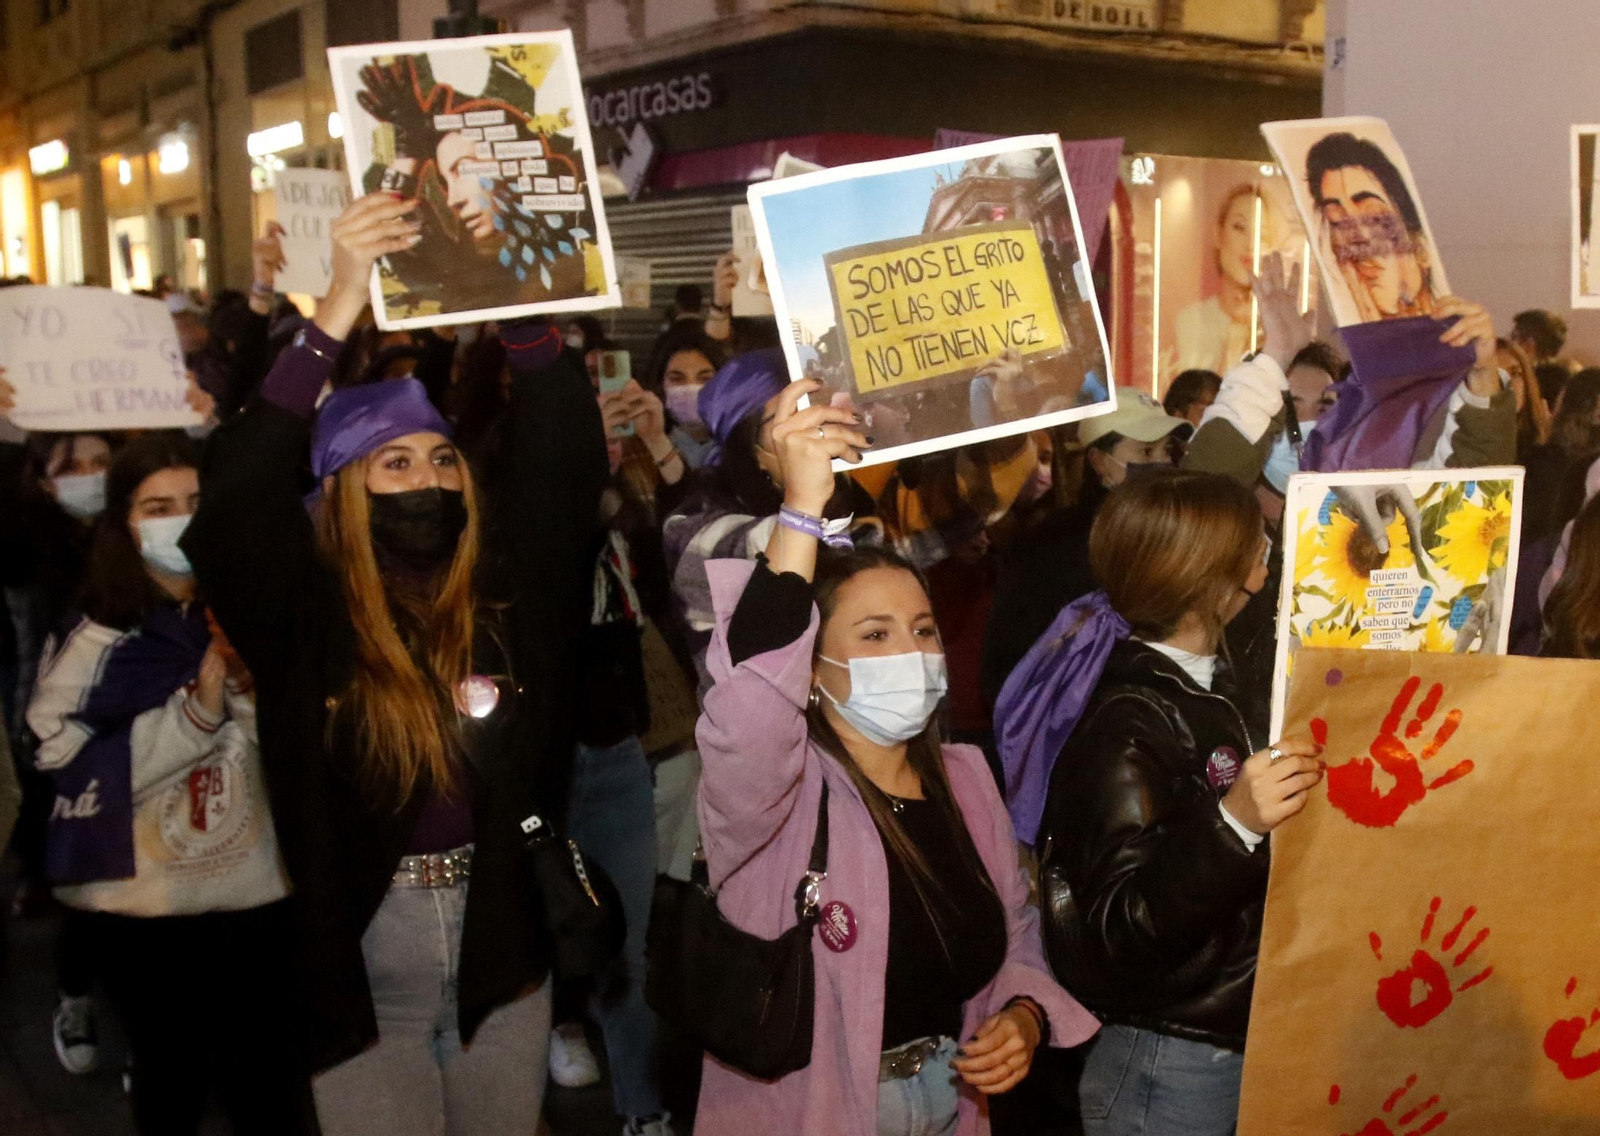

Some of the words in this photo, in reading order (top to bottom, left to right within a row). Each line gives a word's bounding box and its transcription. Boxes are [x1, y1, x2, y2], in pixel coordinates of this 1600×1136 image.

[847, 249, 942, 300] SOMOS
[943, 244, 974, 278] EL
[974, 237, 1025, 270] GRITO
[13, 305, 67, 340] YO
[846, 302, 888, 339] DE
[892, 293, 934, 327] LAS
[941, 282, 986, 317] QUE
[990, 279, 1021, 309] YA
[865, 345, 903, 387] NO
[903, 325, 990, 371] TIENEN
[26, 360, 58, 387] TE
[70, 358, 139, 385] CREO
[1372, 570, 1408, 582] quieren
[1377, 600, 1399, 612] pero
[1401, 599, 1414, 609] no
[1362, 617, 1389, 628] saben
[1391, 617, 1409, 630] que
[1371, 631, 1402, 641] somos
